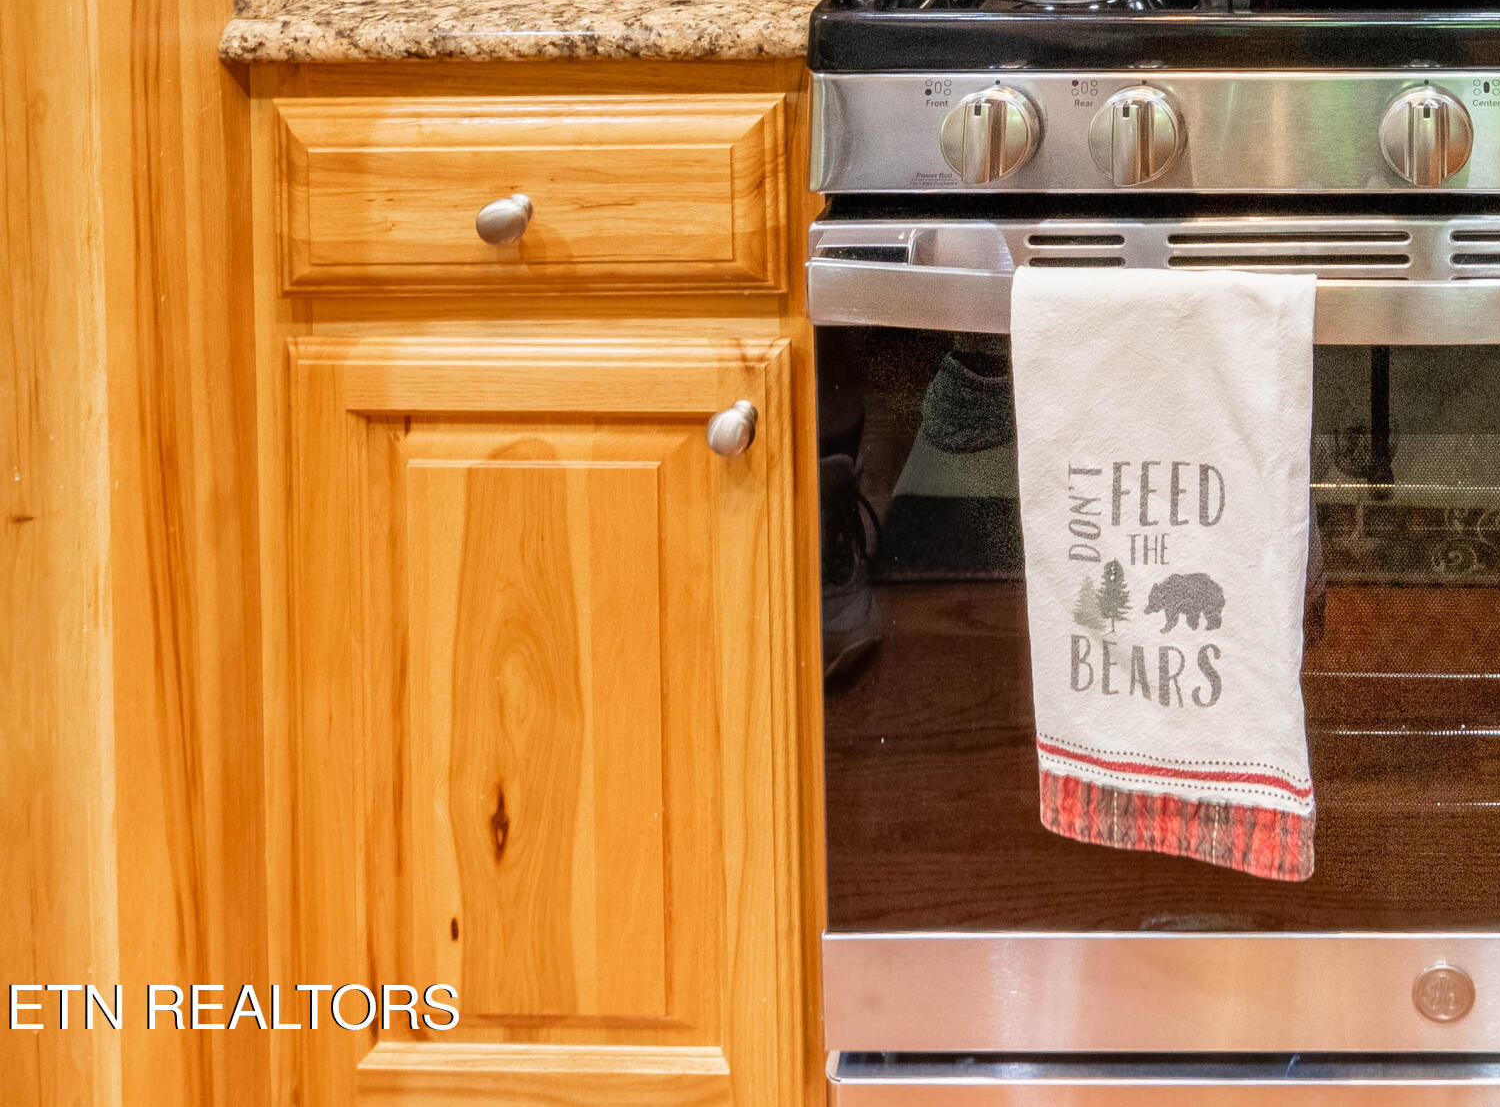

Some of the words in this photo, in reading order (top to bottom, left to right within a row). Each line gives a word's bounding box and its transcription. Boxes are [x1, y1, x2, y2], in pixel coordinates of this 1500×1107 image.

[926, 99, 949, 107] Front
[1074, 99, 1094, 107] Rear
[1472, 99, 1500, 107] Center
[1111, 460, 1226, 528] FEED
[1126, 532, 1170, 566] THE
[1070, 634, 1223, 708] BEARS
